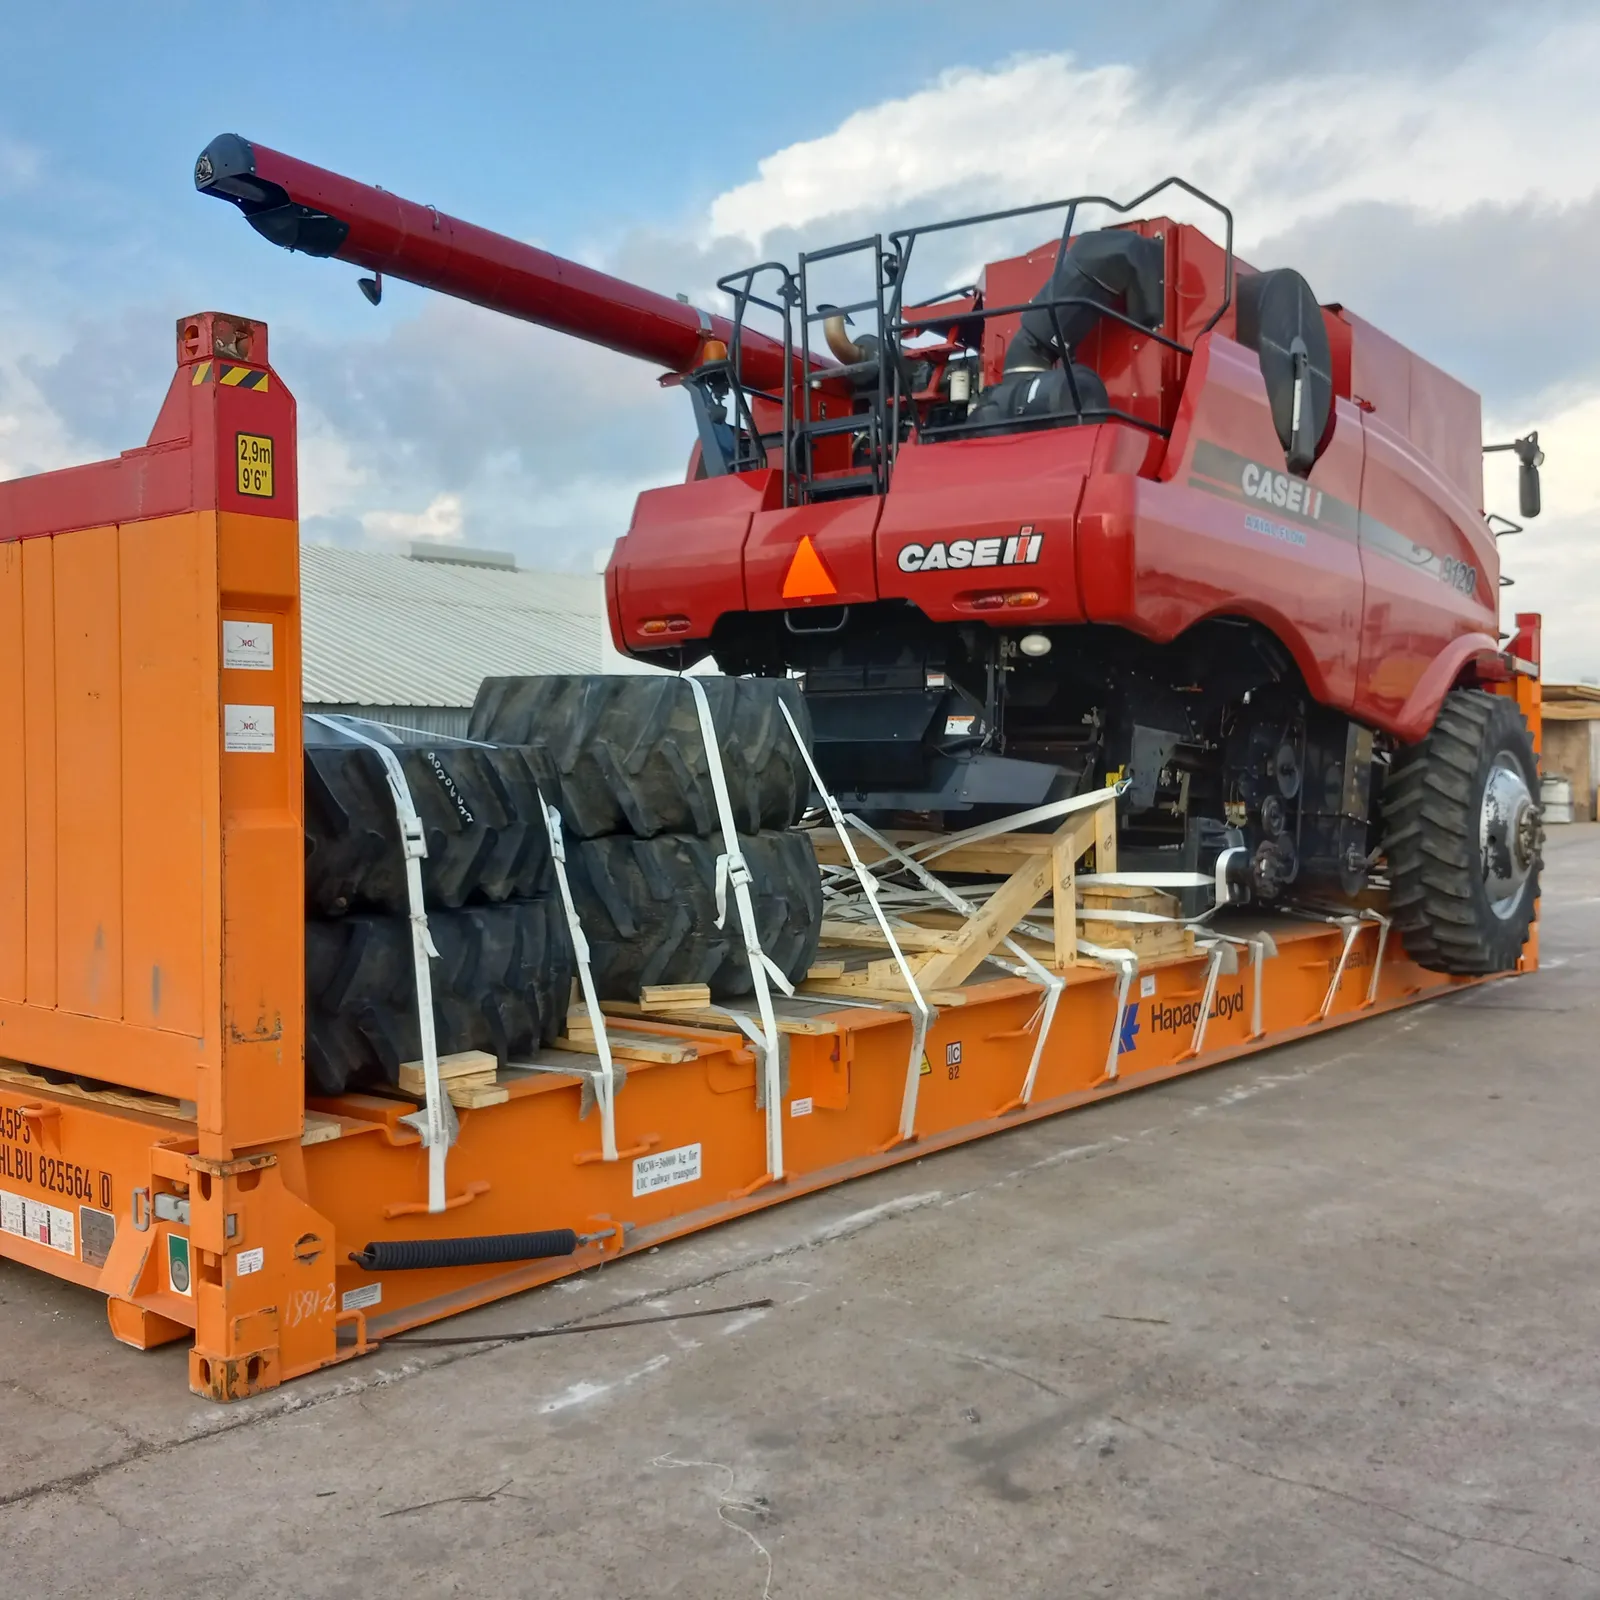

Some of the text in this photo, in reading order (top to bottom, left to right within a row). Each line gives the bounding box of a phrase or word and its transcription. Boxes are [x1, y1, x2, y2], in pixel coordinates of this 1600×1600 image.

[240, 439, 271, 465] 2,9m
[243, 468, 267, 491] 9'6"
[1241, 463, 1303, 513] CASE
[897, 538, 1001, 573] CASE
[948, 1065, 960, 1081] 82
[39, 1155, 93, 1203] 825564
